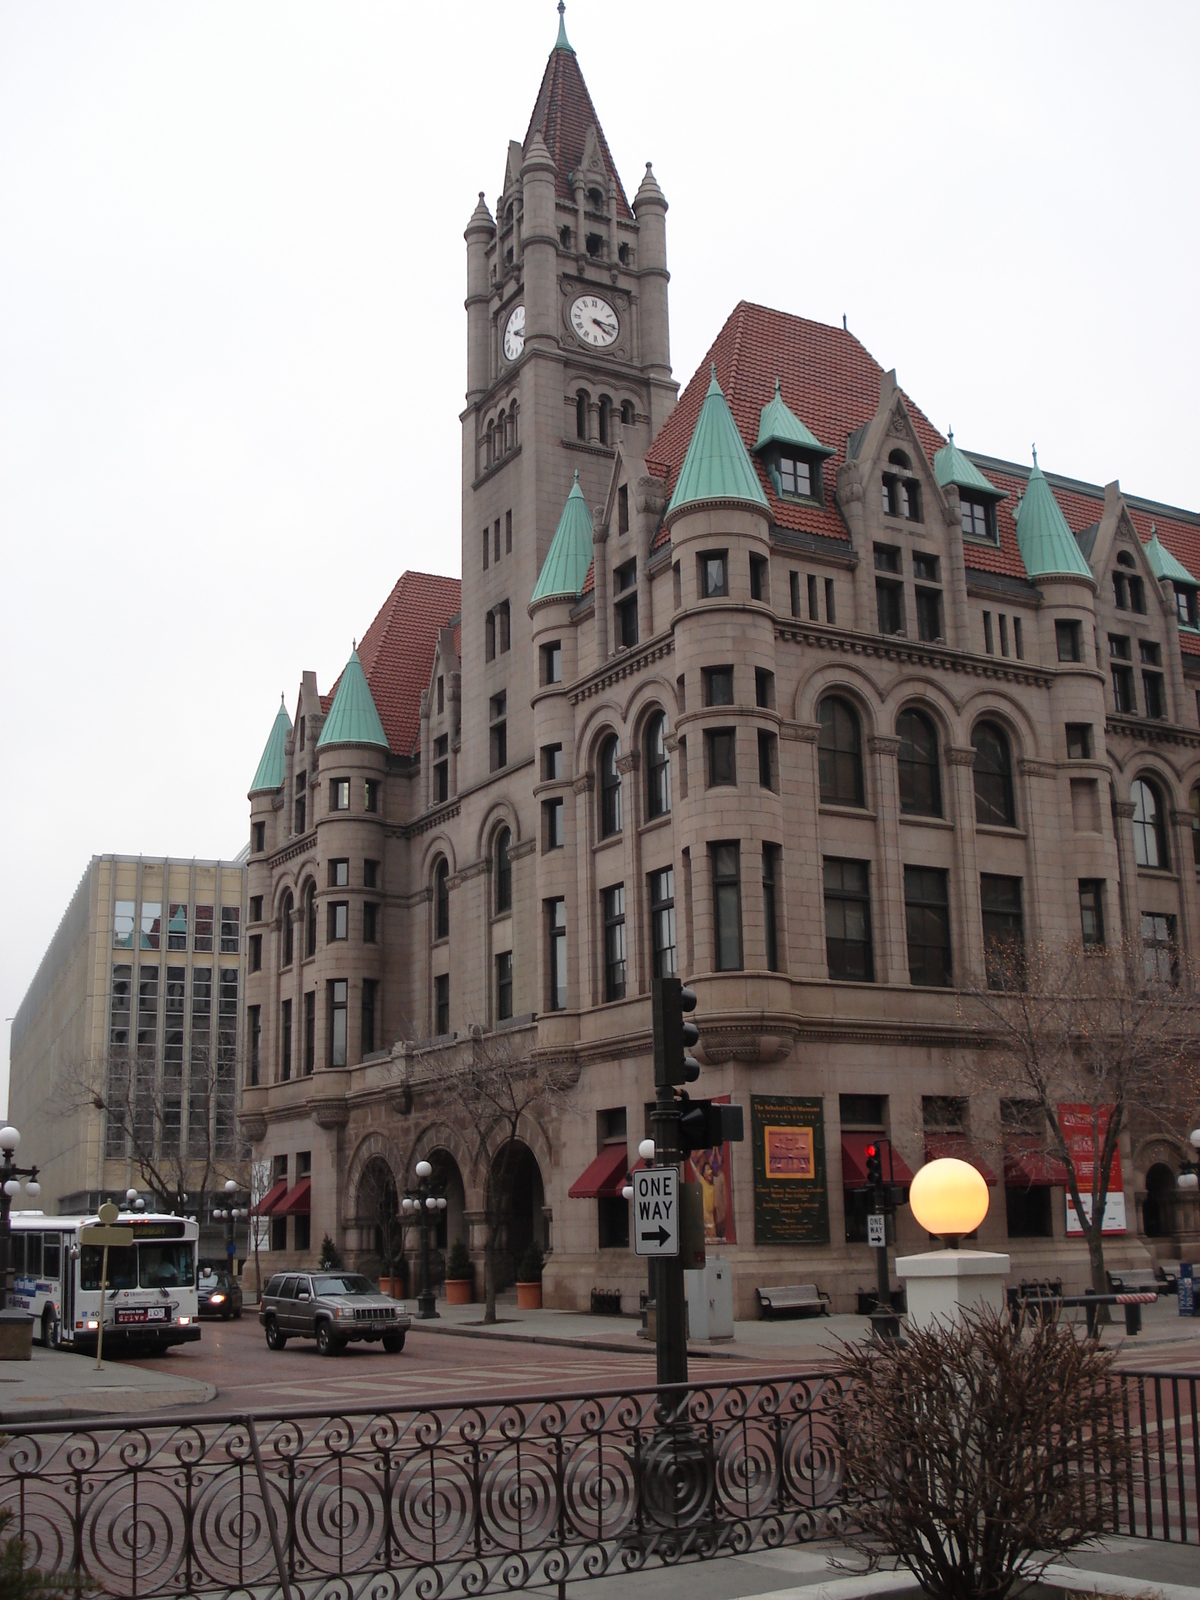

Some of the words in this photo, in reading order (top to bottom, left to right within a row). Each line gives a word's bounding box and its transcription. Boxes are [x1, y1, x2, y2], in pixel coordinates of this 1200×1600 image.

[639, 1177, 672, 1197] ONE
[639, 1200, 673, 1220] WAY
[870, 1217, 883, 1225] ONE
[149, 1309, 165, 1317] 105
